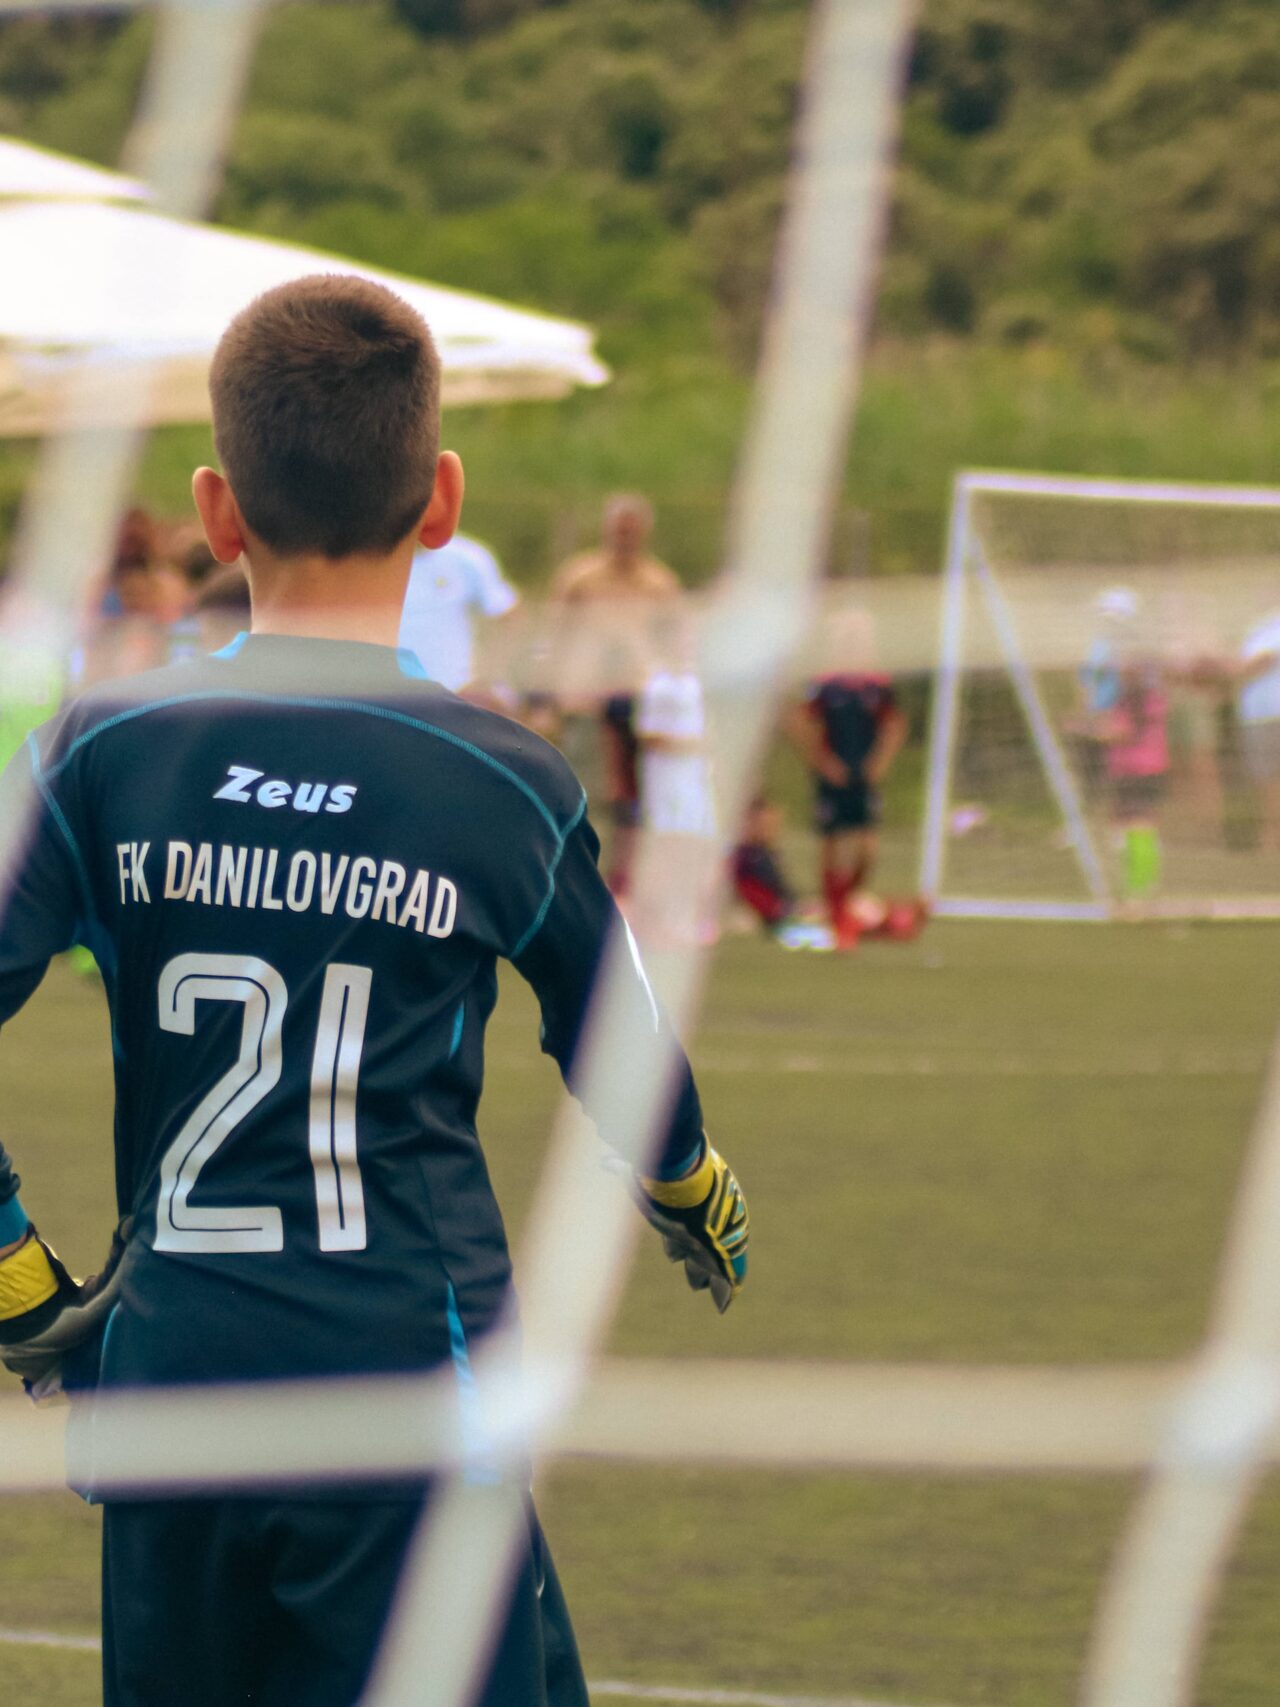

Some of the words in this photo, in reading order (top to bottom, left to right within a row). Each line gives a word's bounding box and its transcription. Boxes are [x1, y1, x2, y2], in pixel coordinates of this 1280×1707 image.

[213, 765, 357, 814] Zeus
[116, 841, 152, 905] FK
[163, 840, 458, 939] DANILOVGRAD
[152, 952, 373, 1254] 21
